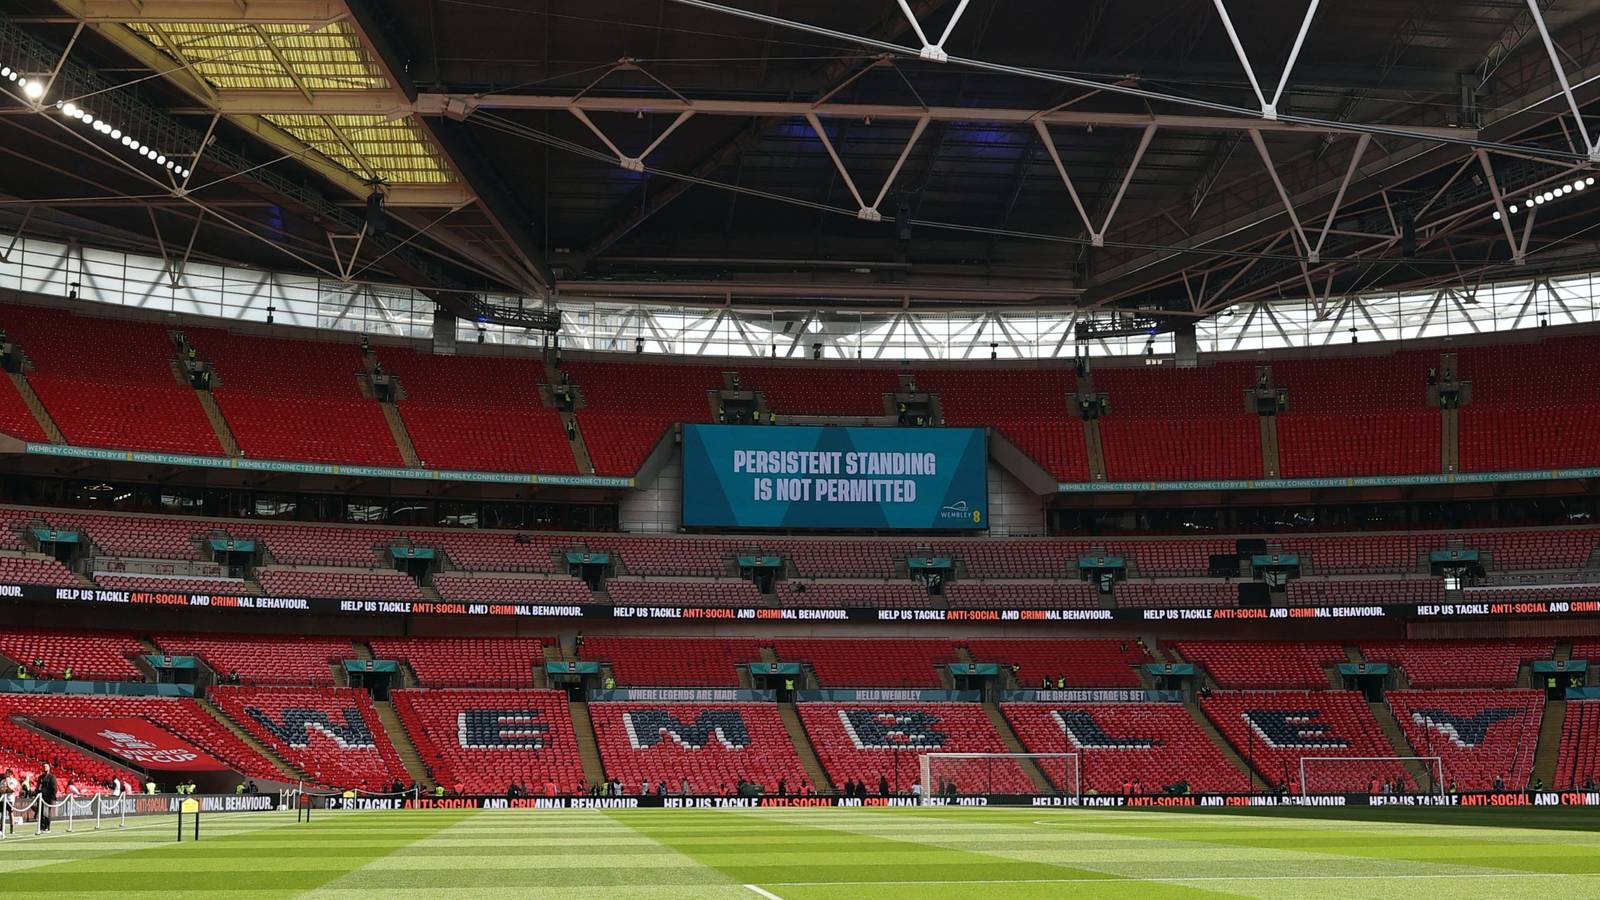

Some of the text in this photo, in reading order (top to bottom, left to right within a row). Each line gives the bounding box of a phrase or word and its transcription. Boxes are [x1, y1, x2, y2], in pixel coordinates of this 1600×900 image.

[63, 448, 106, 457] CONNECTED
[734, 450, 936, 475] PERSISTENT STANDING
[754, 478, 916, 502] IS NOT PERMITTED
[56, 589, 310, 609] HELP US TACKLE ANTI-SOCIAL AND CRIMINAL BEHAVIOUR.
[341, 601, 583, 616] HELP US TACKLE ANTI-SOCIAL AND CRIMINAL BEHAVIOUR.
[614, 607, 848, 620] HELP US TACKLE ANTI-SOCIAL AND CRIMINAL BEHAVIOUR.
[1144, 606, 1385, 619] HELP US TACKLE ANTI-SOCIAL AND CRIMINAL BEHAVIOUR.
[1418, 605, 1439, 615] HELP
[1442, 605, 1453, 614] US
[1455, 604, 1489, 614] TACKLE
[1491, 603, 1548, 613] ANTI-SOCIAL
[1550, 602, 1568, 612] AND
[878, 610, 1113, 620] HELP US TACKLE ANTI-SOCIAL AND CRIMINAL BEHAVIOUR.
[628, 690, 737, 700] WHERE LEGENDS ARE MADE
[856, 690, 920, 700] HELLO WEMBLEY
[1036, 690, 1144, 701] THE GREATEST STAGE IS SET
[152, 753, 198, 762] CUP
[225, 796, 273, 811] BEHAVIOUR.
[357, 799, 401, 809] TACKLE
[404, 799, 478, 808] ANTI-SOCIAL
[483, 799, 508, 808] AND
[511, 799, 567, 808] CRIMINAL
[761, 798, 832, 807] ANTI-SOCIAL
[838, 798, 861, 807] AND
[1127, 797, 1195, 806] ANTI-SOCIAL
[1200, 797, 1224, 806] AND
[1461, 795, 1532, 806] ANTI-SOCIAL
[1534, 794, 1558, 805] AND
